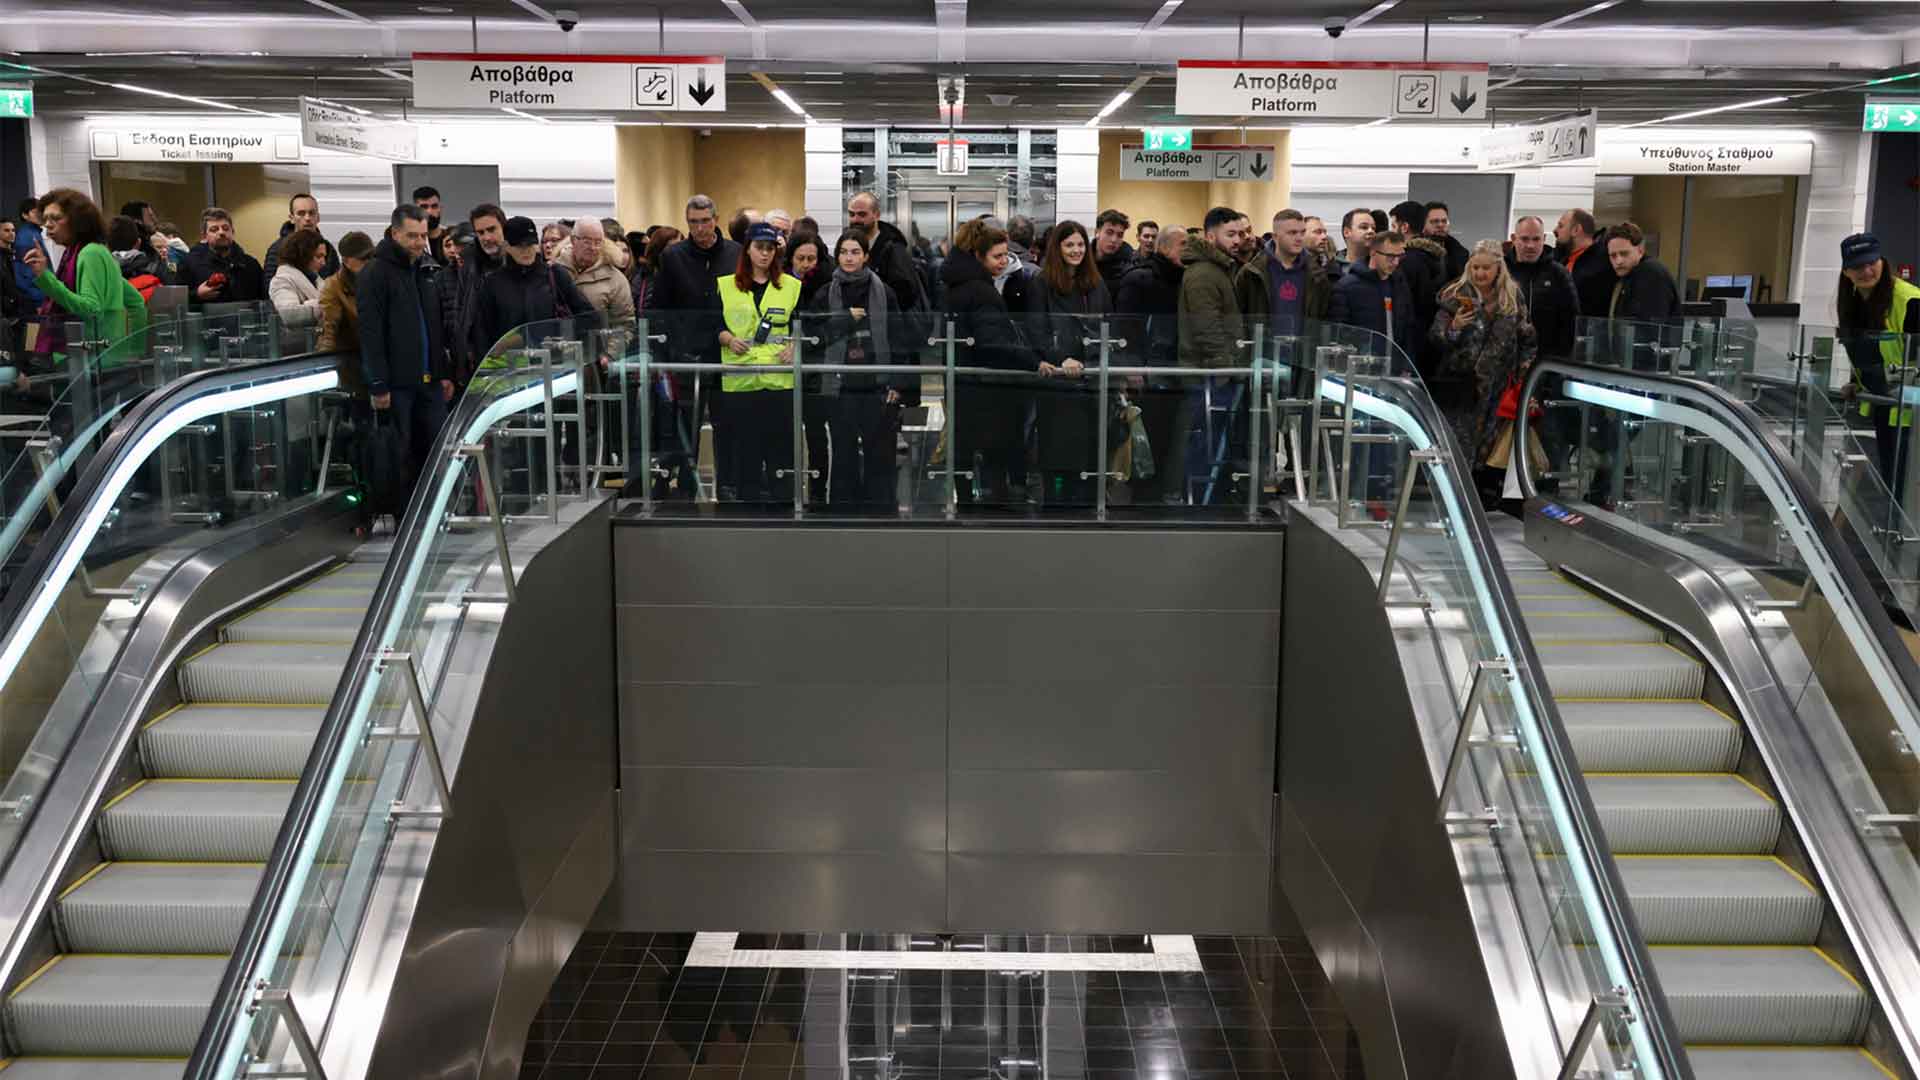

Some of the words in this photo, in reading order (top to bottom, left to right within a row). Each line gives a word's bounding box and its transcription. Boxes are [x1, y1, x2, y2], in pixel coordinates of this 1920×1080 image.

[470, 65, 573, 86] Αποβάθρα
[1233, 72, 1338, 94] Αποβάθρα
[489, 90, 555, 104] Platform
[1251, 97, 1317, 112] Platform
[129, 132, 185, 148] Έκδοση
[189, 133, 263, 149] Εισιτηρίων
[160, 149, 192, 160] Ticket
[195, 149, 234, 161] Issuing
[1134, 151, 1203, 166] Αποβάθρα
[1640, 146, 1713, 161] Υπεύθυνος
[1717, 146, 1774, 161] Σταθμού
[1146, 167, 1190, 177] Platform
[1668, 162, 1704, 172] Station
[1706, 162, 1742, 172] Master
